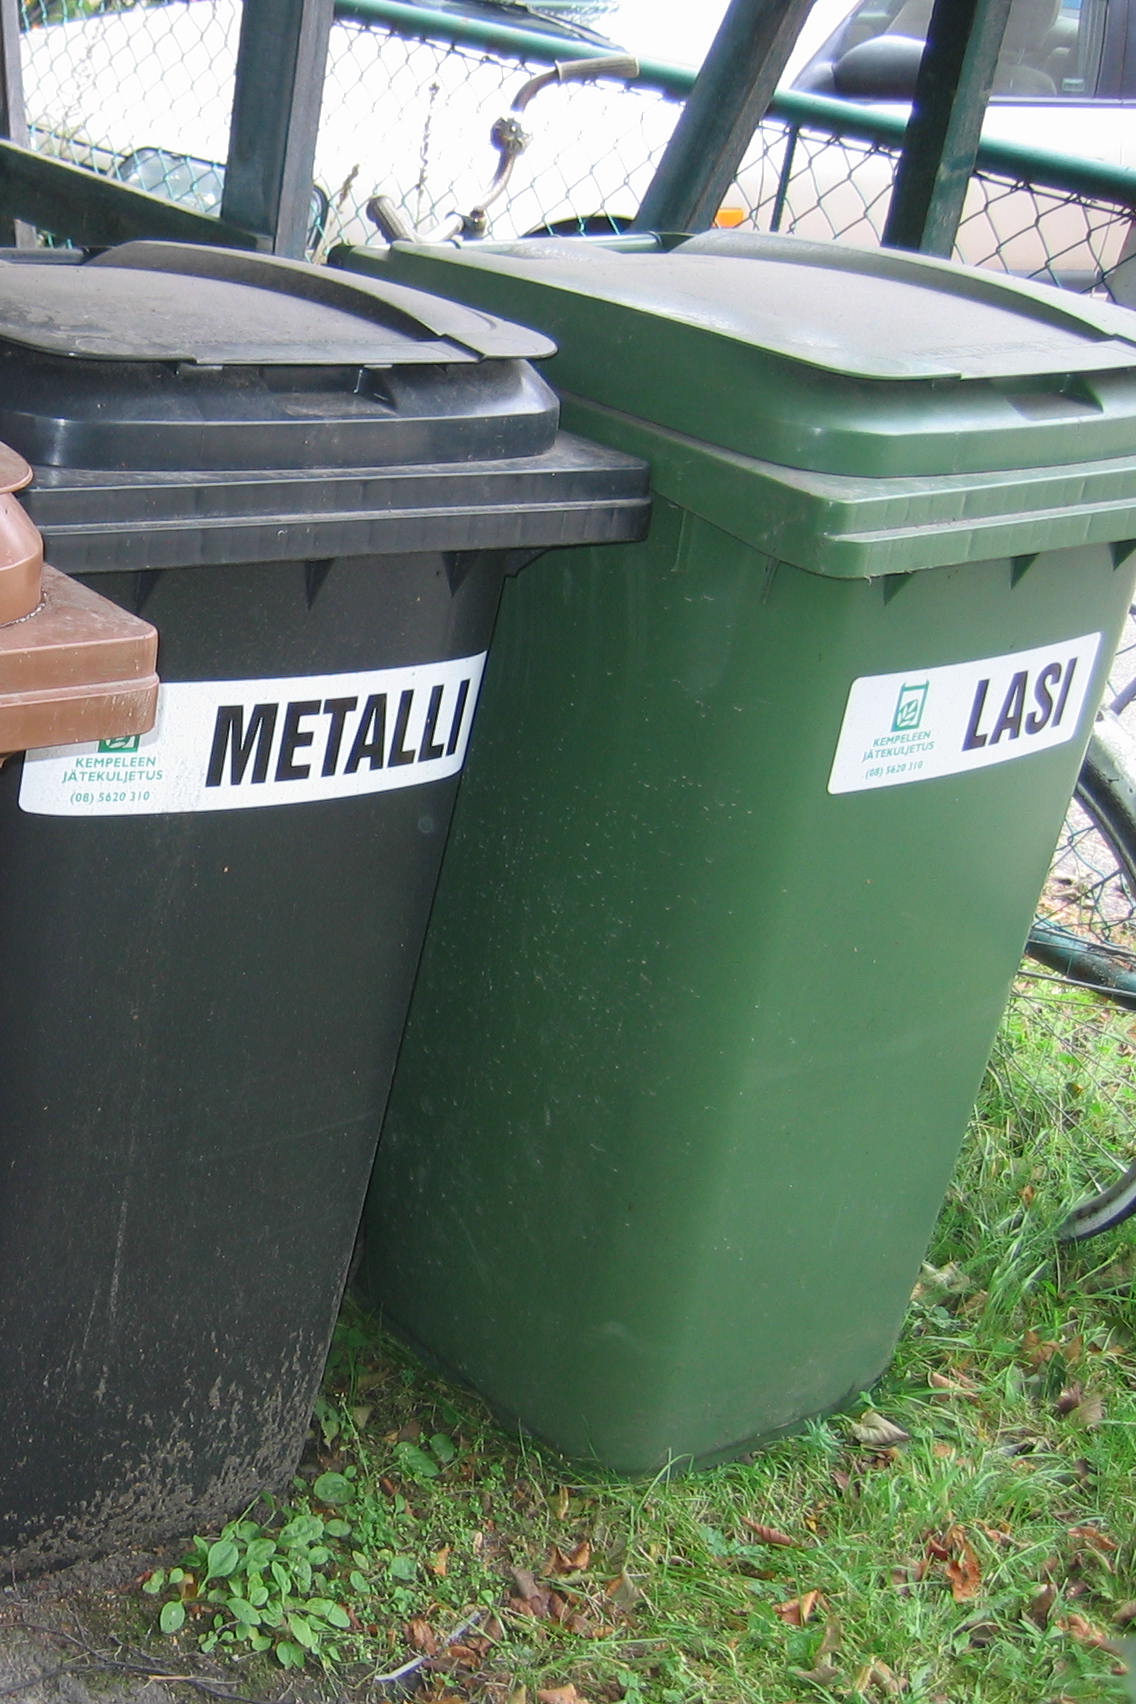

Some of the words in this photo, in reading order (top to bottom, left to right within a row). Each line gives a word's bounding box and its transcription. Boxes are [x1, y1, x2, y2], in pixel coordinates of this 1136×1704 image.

[961, 657, 1078, 751] LASI
[205, 679, 470, 787] METALLI
[872, 730, 932, 747] KEMPELEEN
[75, 756, 156, 769] KEMPELEEN
[61, 769, 163, 784] JÄTEKULJETUS
[70, 791, 94, 805] (08)
[97, 791, 126, 802] 5620
[129, 791, 150, 801] 310
